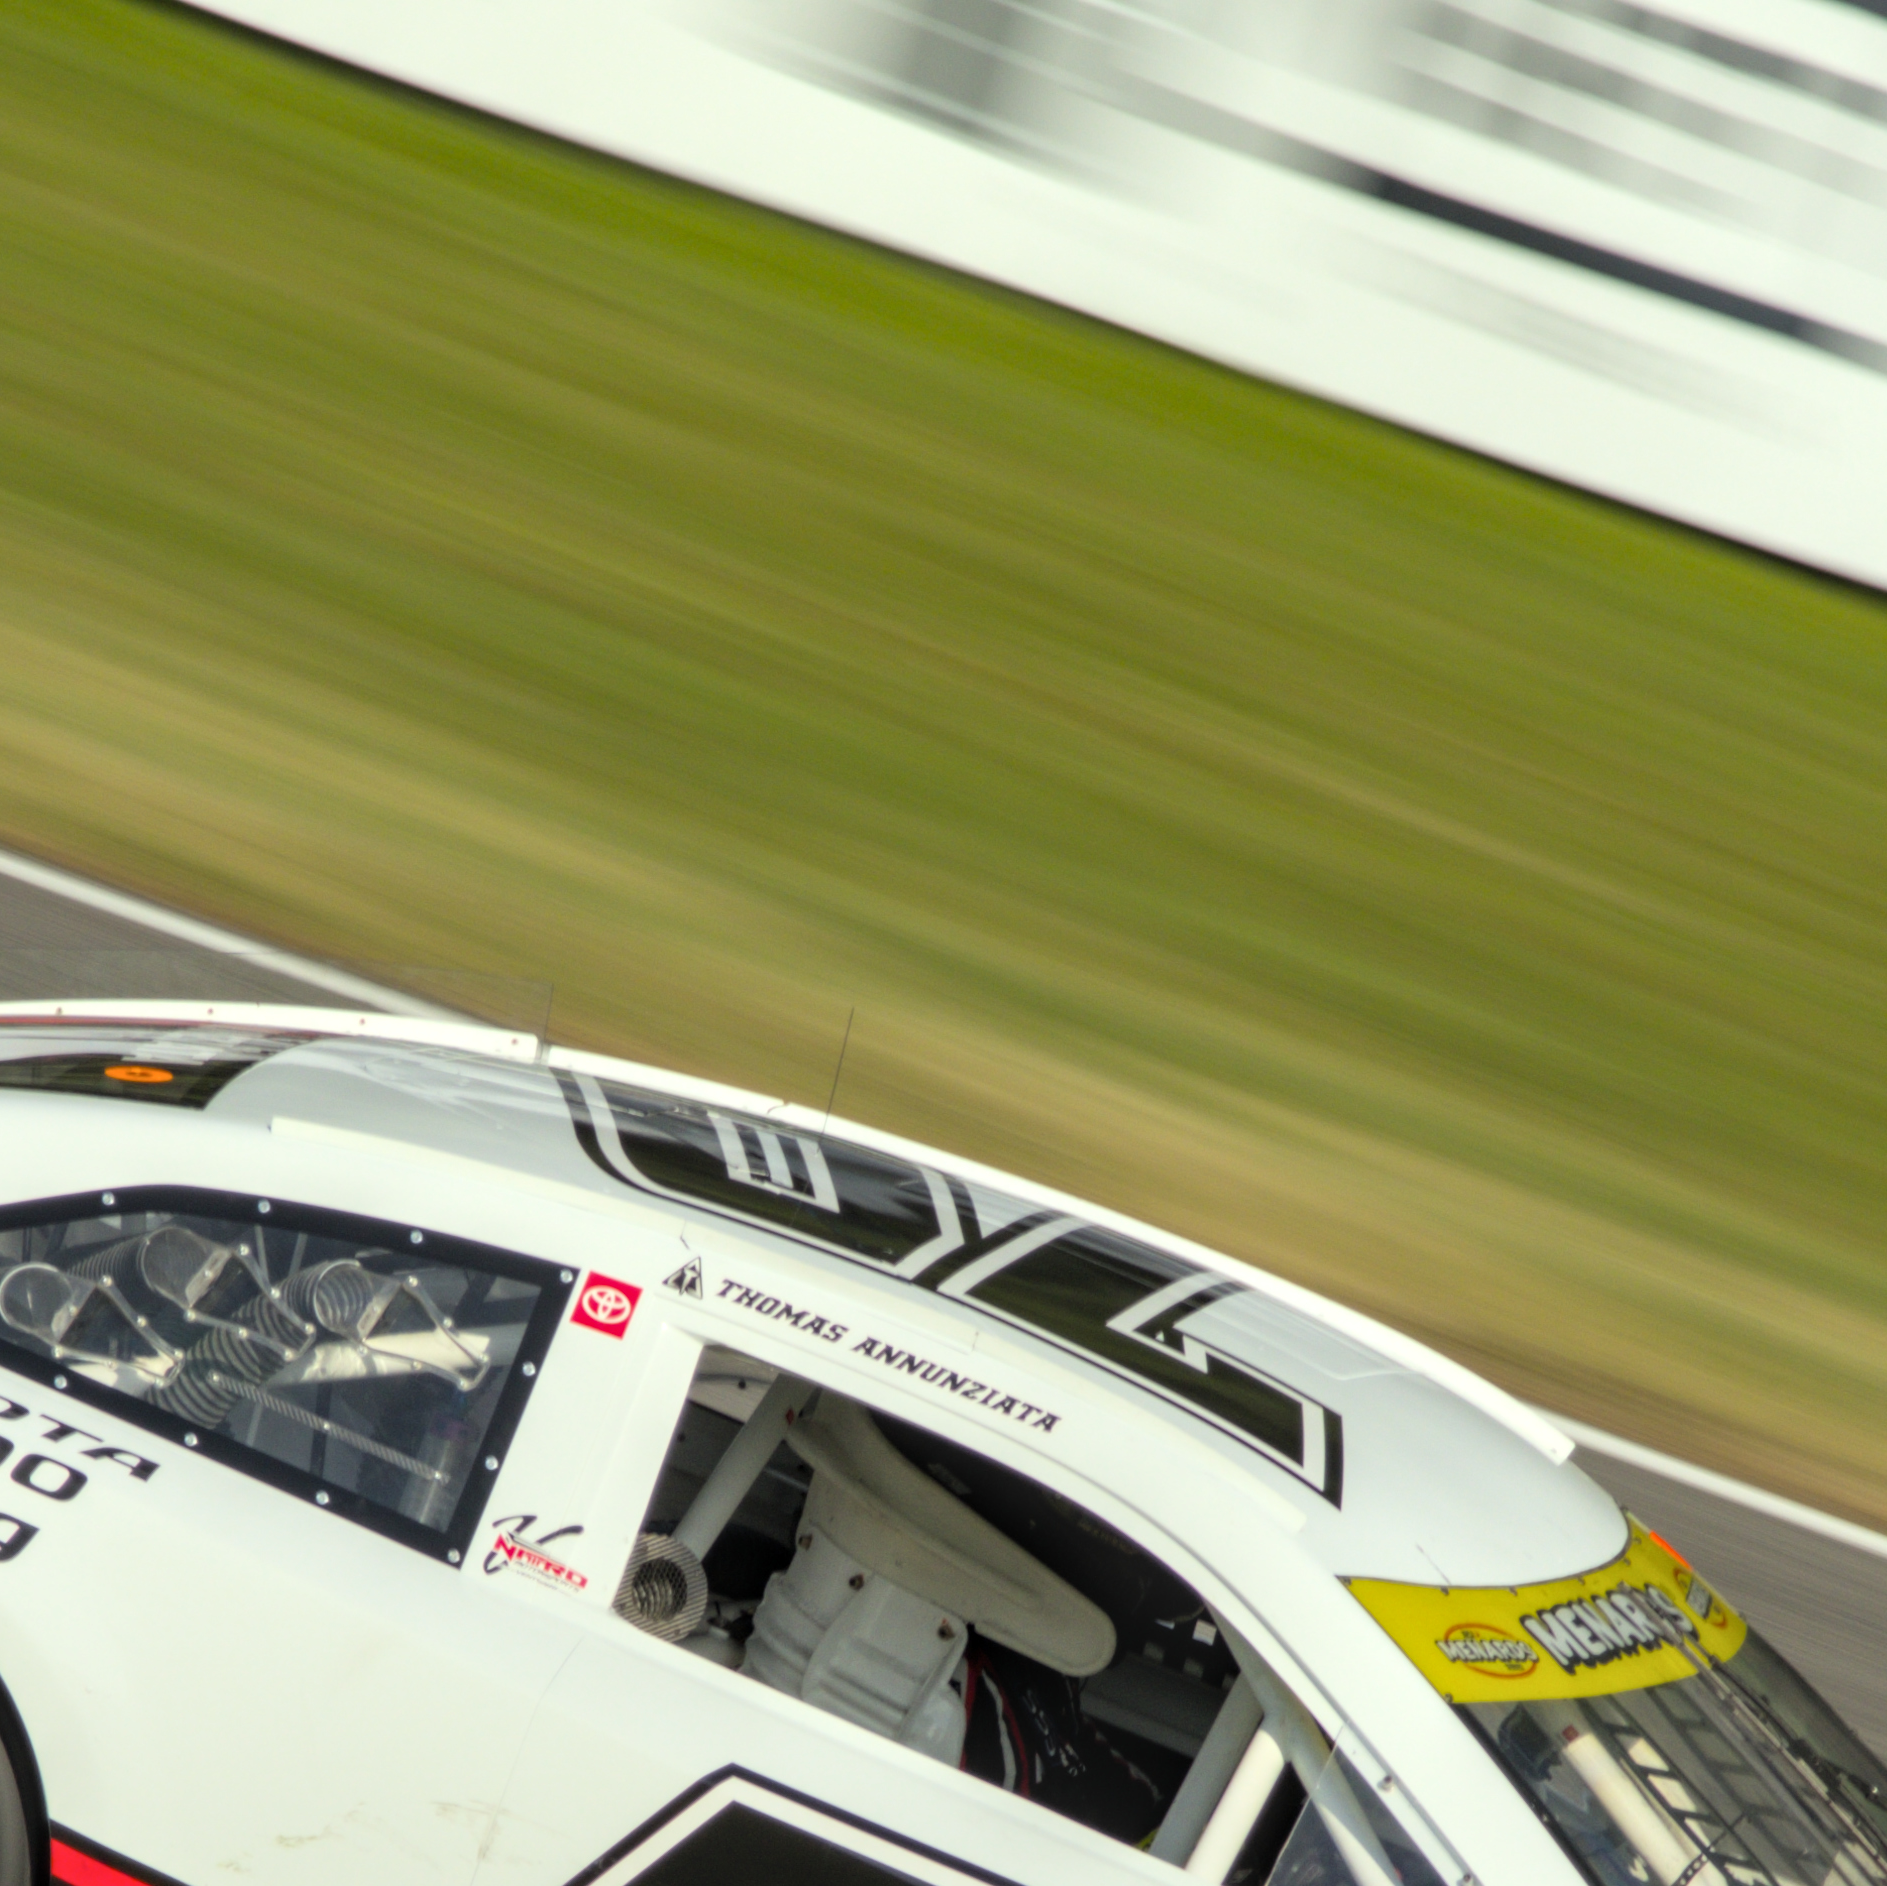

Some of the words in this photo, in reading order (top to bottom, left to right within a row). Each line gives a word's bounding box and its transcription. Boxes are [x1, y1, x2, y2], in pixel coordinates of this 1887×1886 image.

[715, 1278, 850, 1344] THOMAS
[851, 1336, 1061, 1433] ANNUNZIATA
[1435, 1640, 1539, 1663] MENARDS
[1519, 1583, 1700, 1676] MENARS
